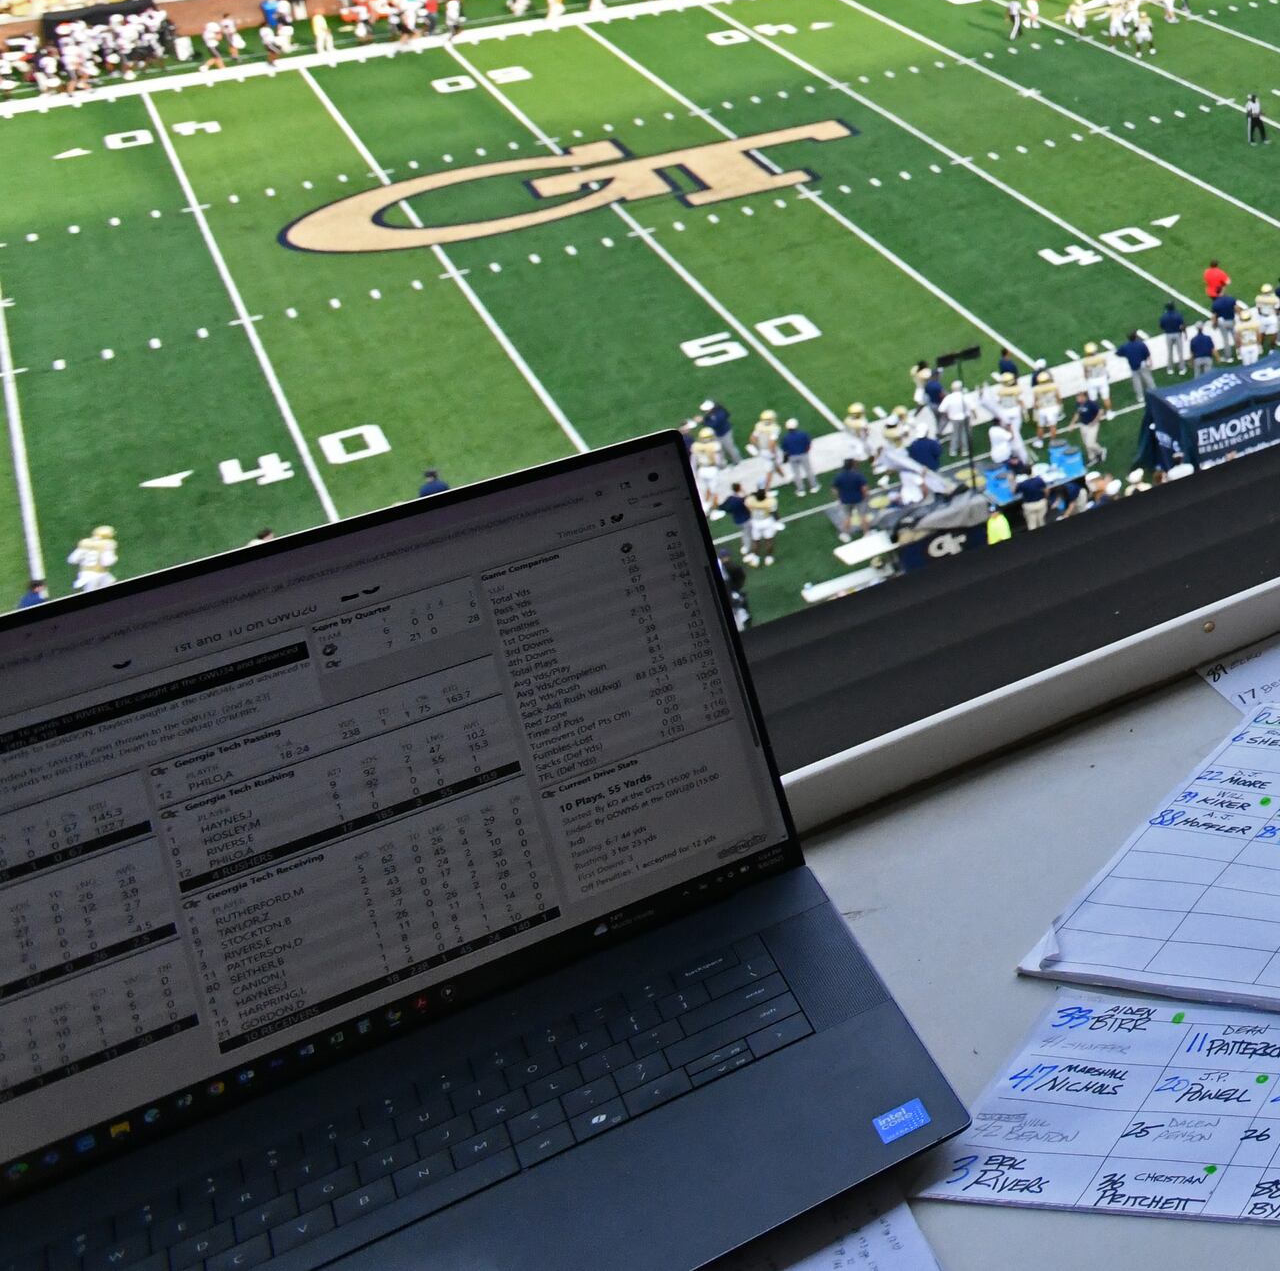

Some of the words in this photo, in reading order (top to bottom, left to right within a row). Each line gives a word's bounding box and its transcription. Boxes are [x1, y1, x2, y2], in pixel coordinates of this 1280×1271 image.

[1037, 226, 1163, 267] 40
[679, 312, 823, 367] 50
[1197, 408, 1264, 447] EMORY
[1197, 427, 1262, 454] HEALTHCARE
[218, 422, 391, 487] 40
[481, 569, 507, 582] Game
[508, 553, 560, 573] Comparison
[173, 747, 216, 769] Georgia
[241, 729, 282, 748] Passing
[558, 776, 591, 793] Current
[617, 759, 639, 772] Stats
[1220, 775, 1272, 790] MOORE
[184, 791, 226, 812] Georgia
[252, 769, 295, 791] Rushing
[559, 802, 573, 815] 10
[623, 773, 653, 791] Yards
[1197, 797, 1252, 811] KIKER
[207, 880, 248, 901] Georgia
[275, 853, 325, 879] Receiving
[1051, 1006, 1093, 1029] 33
[1088, 1016, 1152, 1033] BIRR
[1033, 1076, 1124, 1097] NICHOLS
[1175, 1083, 1252, 1104] POWELL
[1121, 1121, 1165, 1139] 25
[1240, 1128, 1271, 1141] 26
[946, 1155, 979, 1184] 3
[962, 1169, 1052, 1195] RIVERS
[1133, 1172, 1209, 1186] CHRISTIAN
[1094, 1189, 1206, 1212] PRITCHETT
